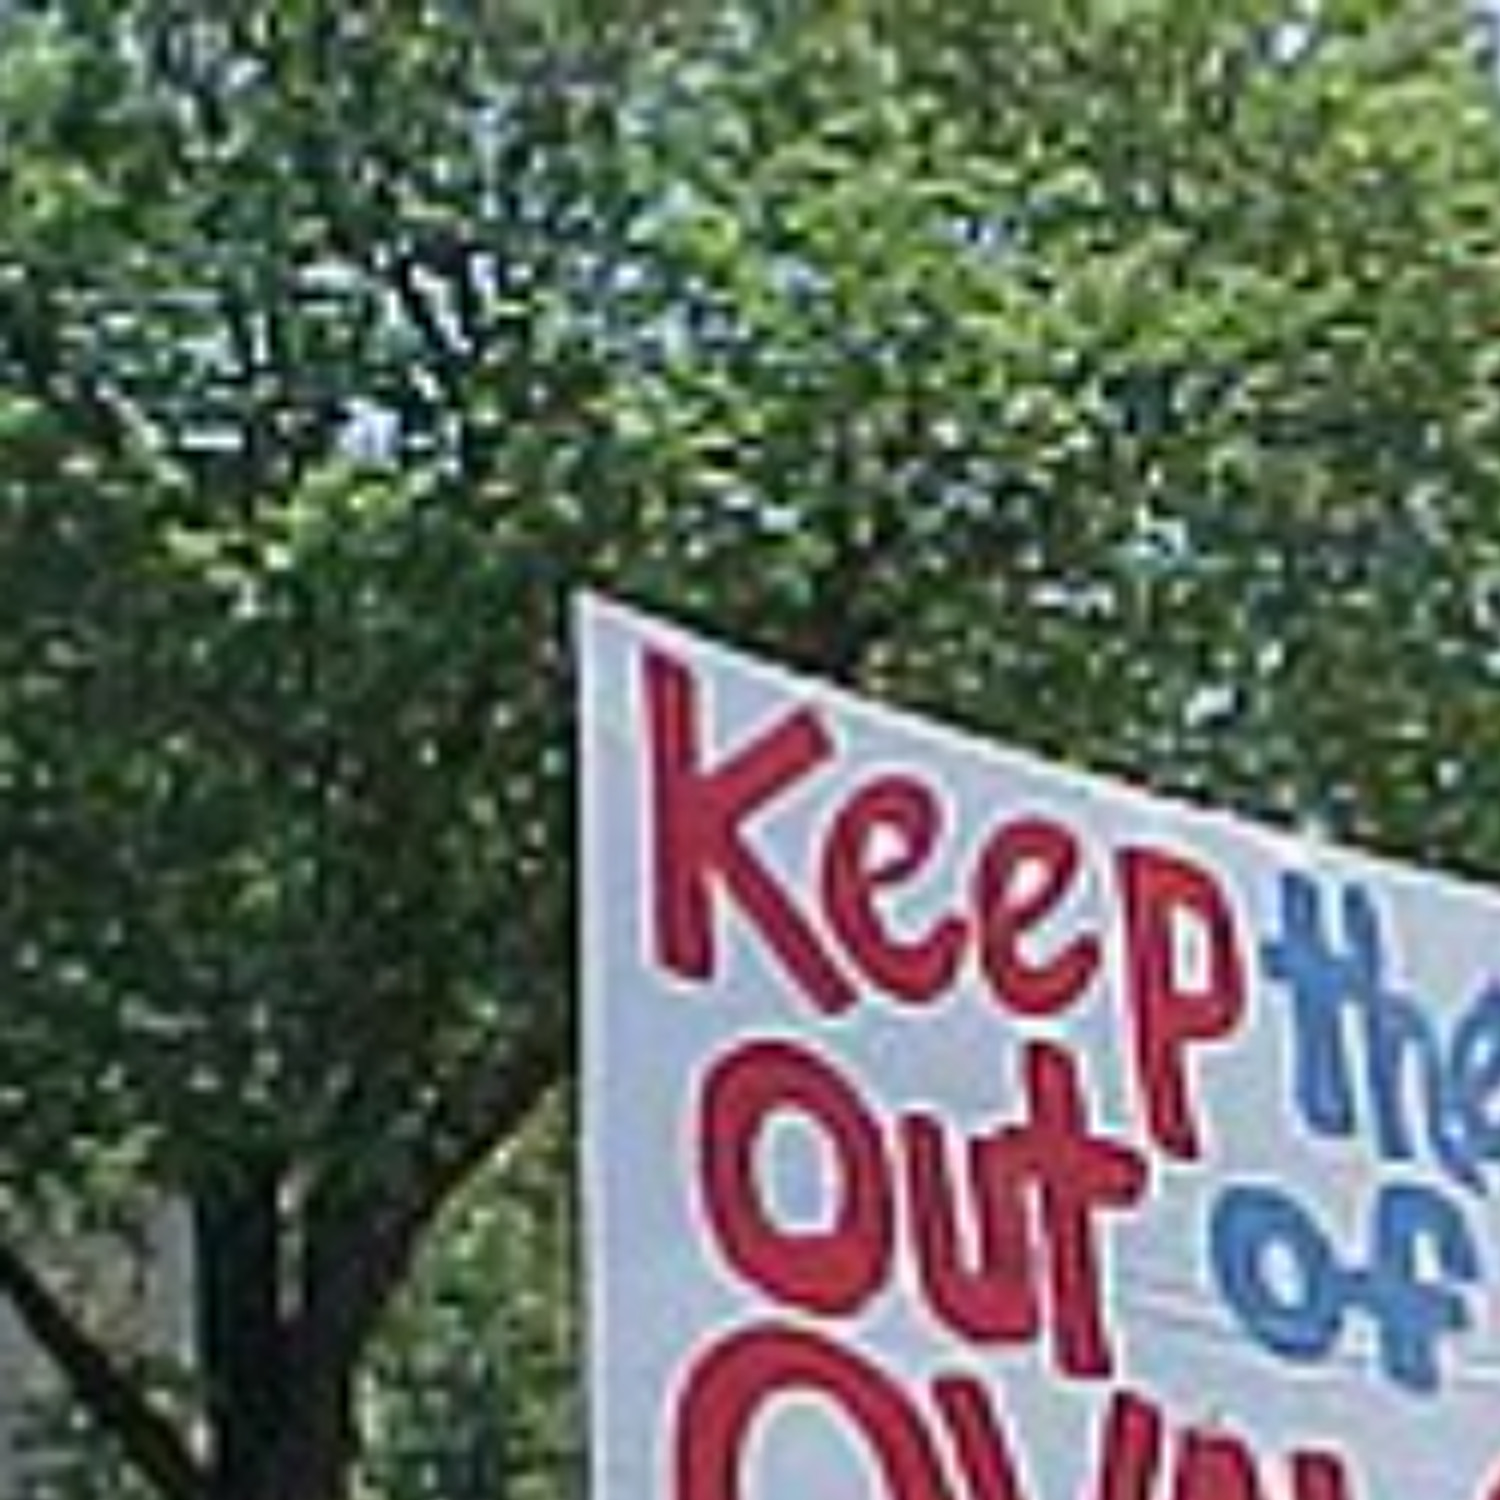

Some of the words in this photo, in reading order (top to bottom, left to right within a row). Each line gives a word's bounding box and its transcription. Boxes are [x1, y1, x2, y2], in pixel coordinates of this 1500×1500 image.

[641, 645, 1247, 1161] Keep
[699, 1039, 1150, 1378] Out
[1208, 1185, 1478, 1392] of
